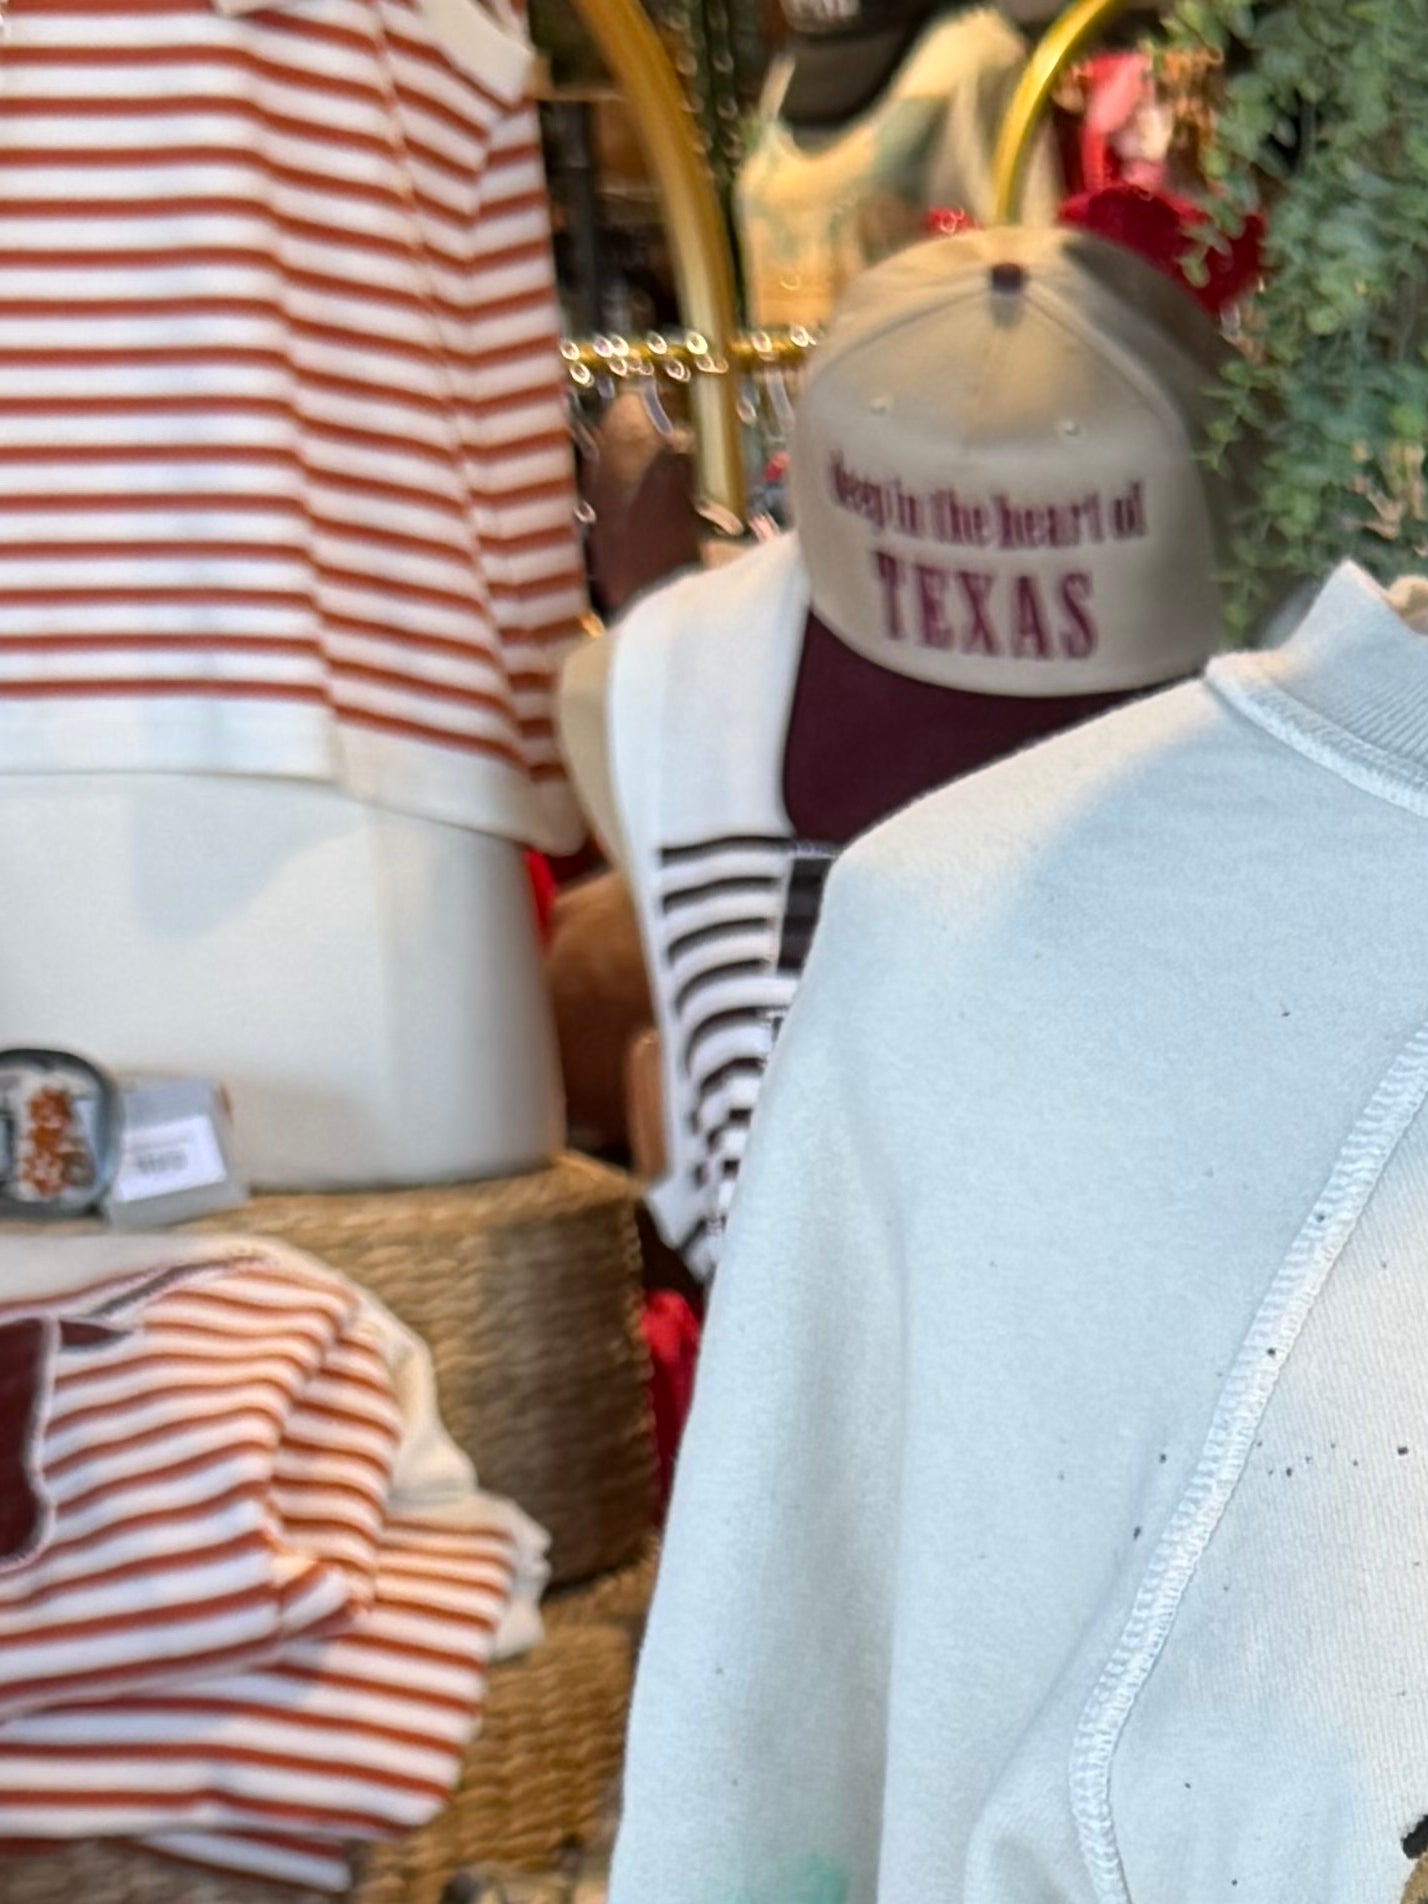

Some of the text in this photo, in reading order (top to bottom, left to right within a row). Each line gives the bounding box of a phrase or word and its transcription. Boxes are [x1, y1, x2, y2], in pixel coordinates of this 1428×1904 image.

[928, 487, 988, 547] the
[990, 491, 1104, 549] heart
[1112, 480, 1148, 541] of
[870, 548, 1098, 660] TEXAS
